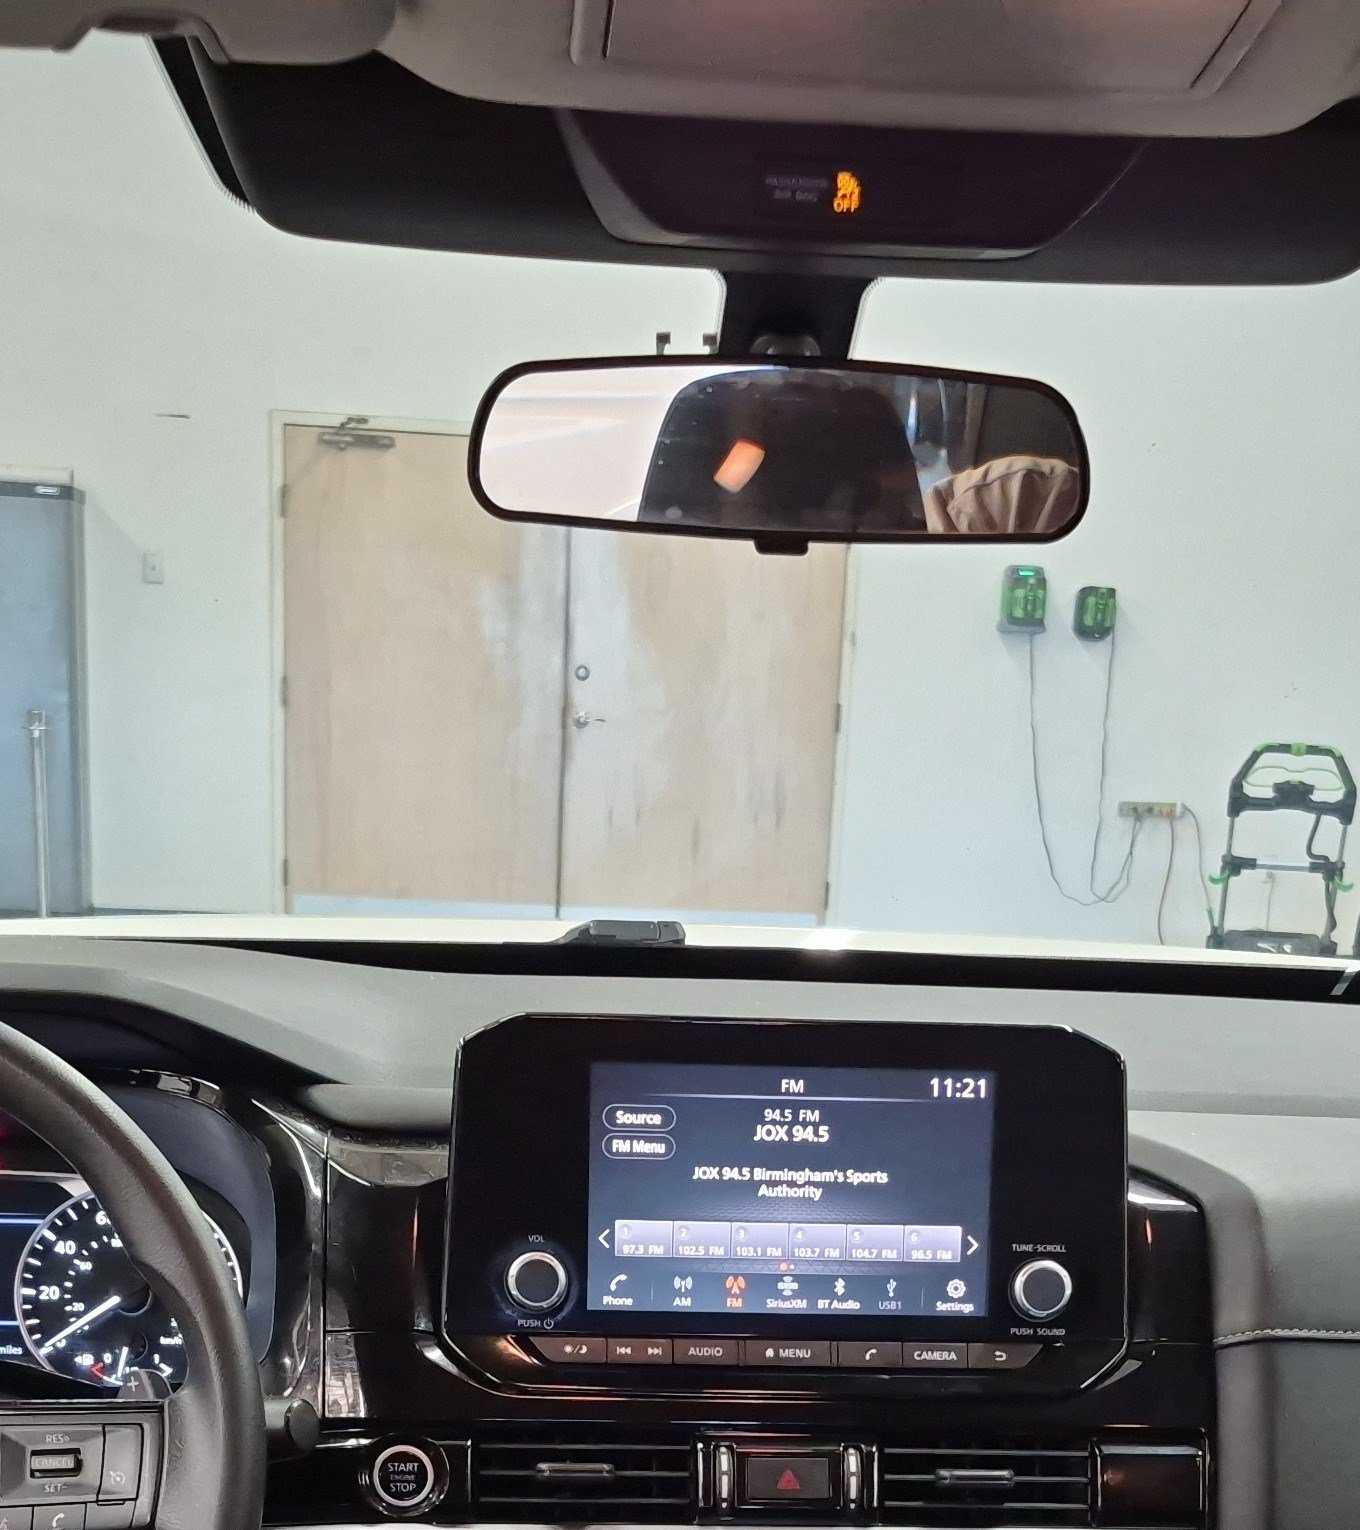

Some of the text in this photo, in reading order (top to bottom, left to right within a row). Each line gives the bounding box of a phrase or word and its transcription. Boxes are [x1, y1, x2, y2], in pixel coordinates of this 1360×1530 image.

[781, 1079, 804, 1093] FM
[930, 1077, 987, 1098] 11:21
[616, 1110, 662, 1125] Source
[764, 1108, 820, 1123] 94.5 FM
[753, 1124, 829, 1142] JOX 94.5
[612, 1139, 665, 1154] FM Menu
[692, 1166, 888, 1185] JOX 94.5 Birmingham's Sports
[758, 1184, 822, 1201] Authority
[527, 1234, 545, 1243] VOL
[680, 1228, 687, 1238] 2
[738, 1229, 745, 1239] 3
[795, 1230, 803, 1239] 4
[853, 1232, 861, 1241] 5
[910, 1232, 918, 1242] 6
[53, 1240, 76, 1255] 40
[622, 1244, 664, 1256] 97.3 FM
[678, 1245, 724, 1256] 102.5 FM
[736, 1246, 782, 1257] 103.1 FM
[793, 1248, 840, 1258] 103.7 FM
[851, 1249, 898, 1259] 104.7 FM
[911, 1249, 952, 1260] 96.5 FM
[39, 1285, 60, 1300] 20
[602, 1295, 634, 1306] Phone
[672, 1297, 692, 1307] AM
[726, 1298, 743, 1308] FM
[766, 1299, 807, 1309] SiriusXM
[817, 1300, 861, 1310] BT Audio
[878, 1301, 902, 1310] USB1
[936, 1301, 975, 1314] Settings
[517, 1319, 541, 1328] PUSH
[1010, 1327, 1066, 1336] PUSH SOUND
[688, 1346, 723, 1357] AUDIO
[779, 1348, 811, 1359] MENU
[913, 1351, 958, 1362] CAMERA
[387, 1462, 420, 1472] START
[390, 1482, 417, 1492] STOP
